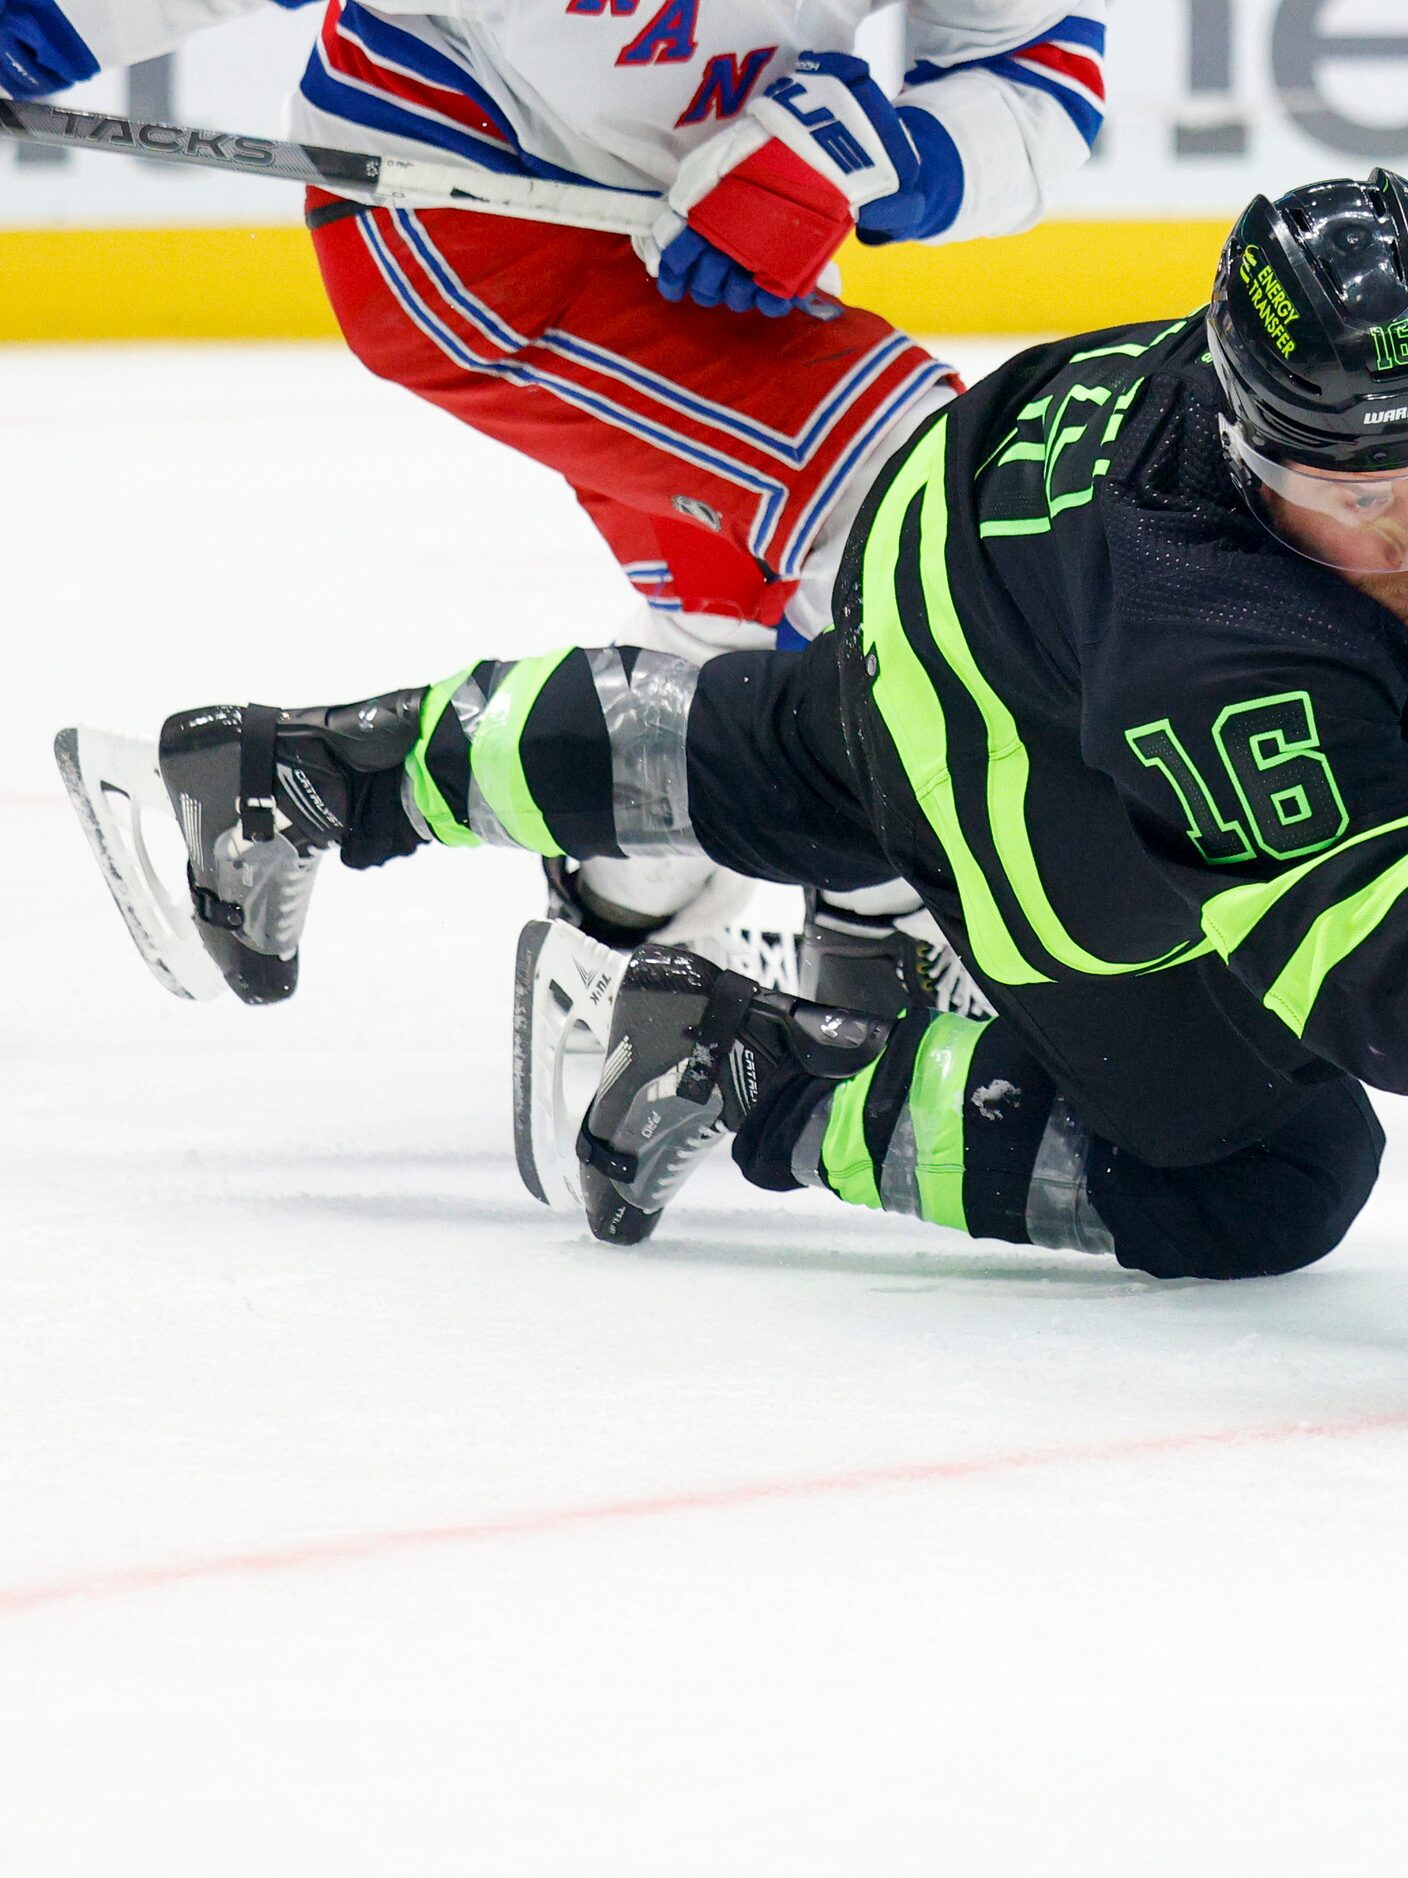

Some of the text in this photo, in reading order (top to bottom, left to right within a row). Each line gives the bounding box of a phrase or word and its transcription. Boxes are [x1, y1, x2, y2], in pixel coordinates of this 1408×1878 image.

[565, 0, 779, 129] AN
[52, 106, 277, 168] TACKS
[1248, 278, 1296, 360] TRANSFER
[1257, 264, 1300, 325] ENERGY
[294, 768, 344, 829] CATALYST
[1125, 689, 1350, 866] 16
